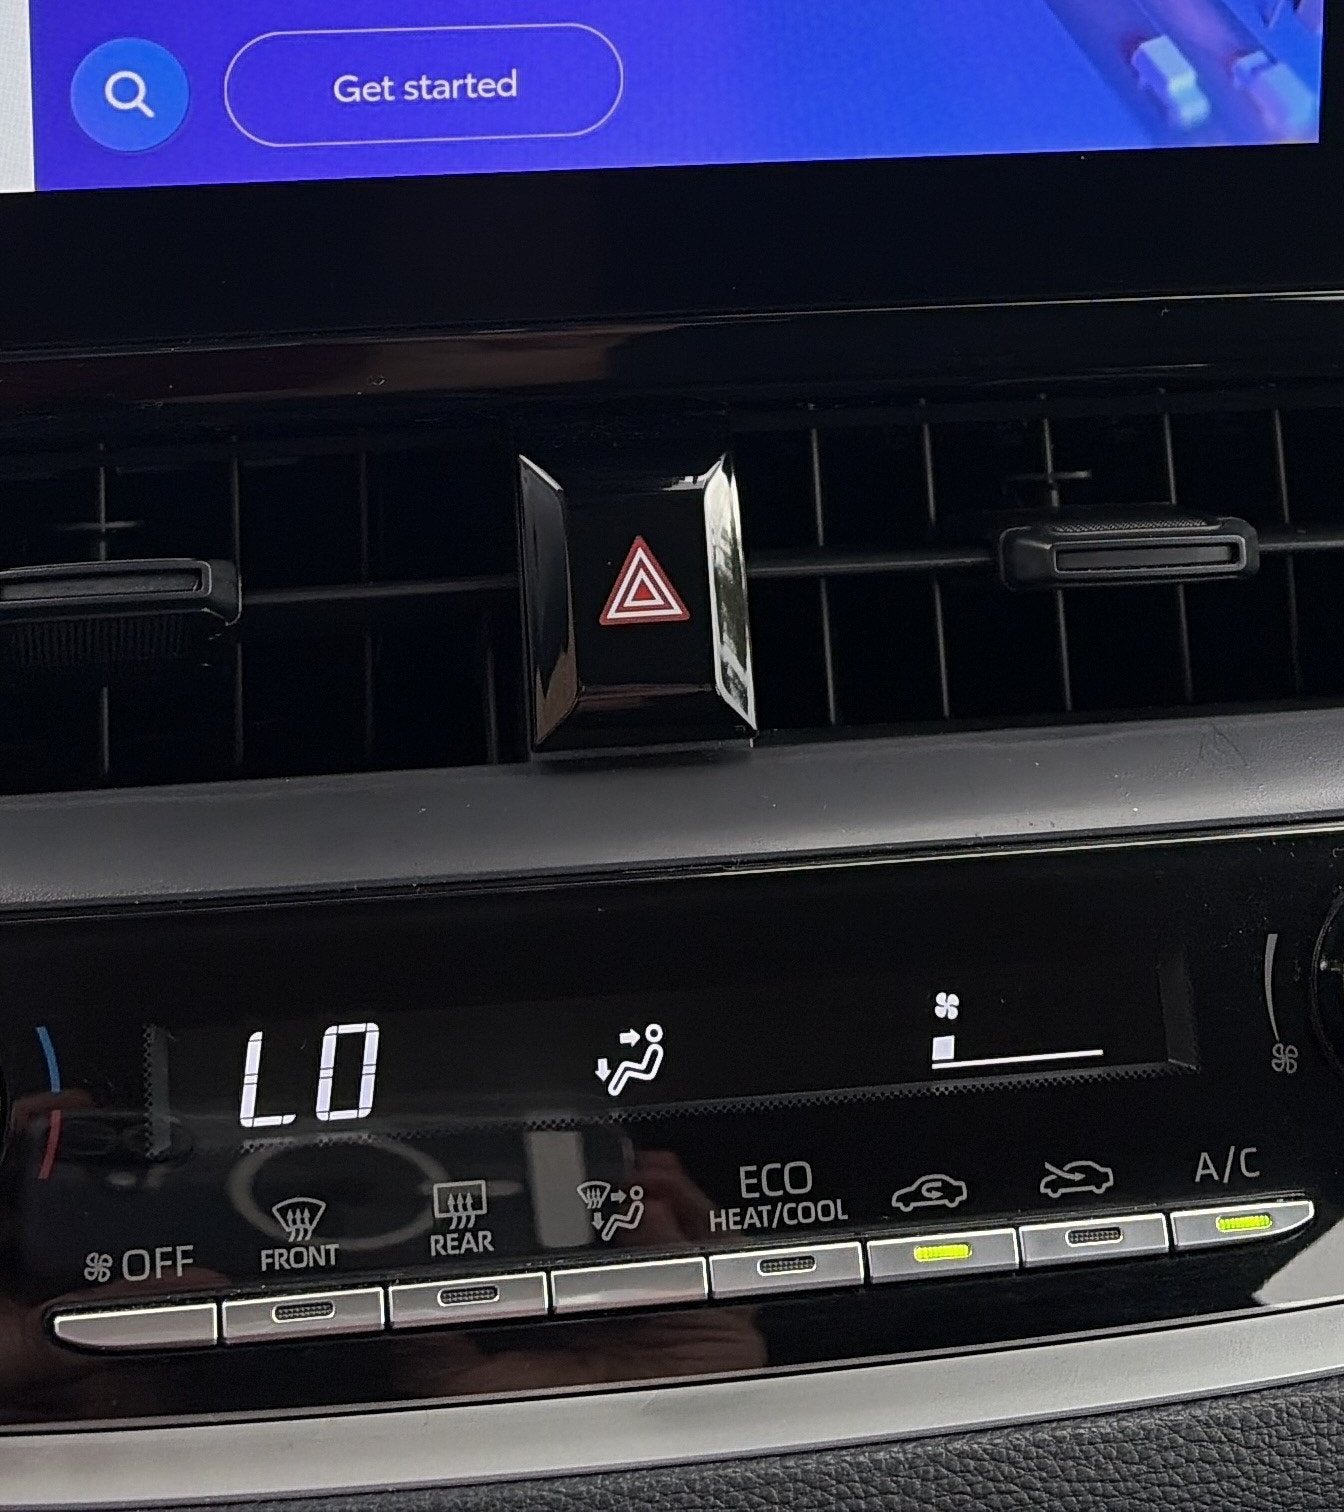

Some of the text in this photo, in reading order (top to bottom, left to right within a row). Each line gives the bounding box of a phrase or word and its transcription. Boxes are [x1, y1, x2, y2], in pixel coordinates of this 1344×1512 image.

[333, 68, 517, 103] Get started
[239, 1022, 380, 1128] LO
[739, 1160, 813, 1199] ECO
[1194, 1145, 1260, 1184] A/C
[709, 1197, 849, 1232] HEAT/COOL
[260, 1242, 340, 1271] FRONT
[430, 1230, 495, 1257] REAR
[121, 1244, 194, 1282] OFF
